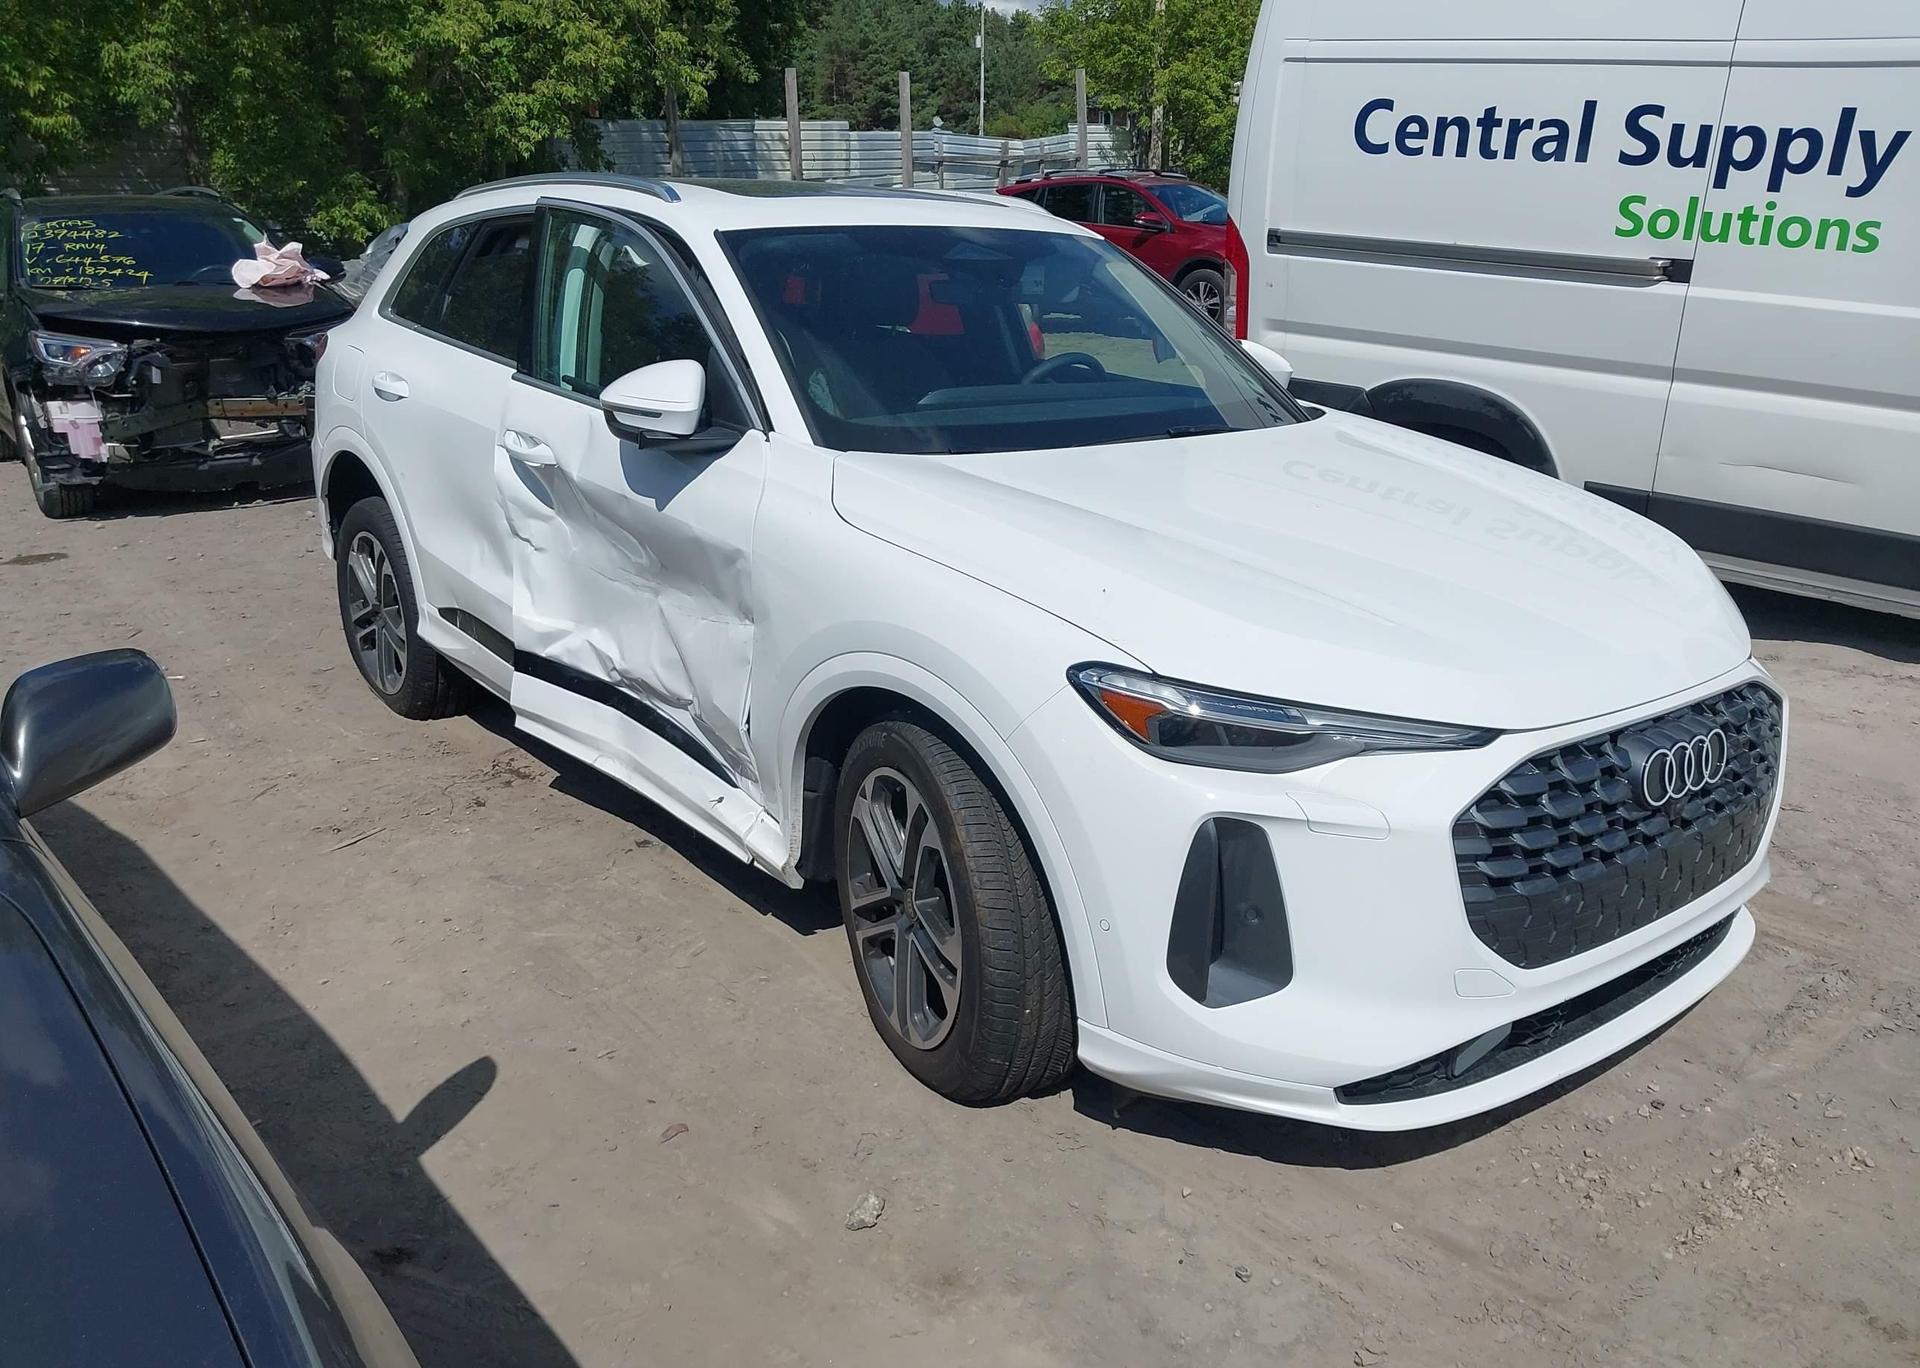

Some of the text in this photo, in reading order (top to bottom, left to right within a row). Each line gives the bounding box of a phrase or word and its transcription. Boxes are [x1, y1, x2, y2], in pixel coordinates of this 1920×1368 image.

[1354, 97, 1912, 198] Central Supply
[64, 242, 108, 255] RAV4
[1614, 194, 1882, 254] Solutions
